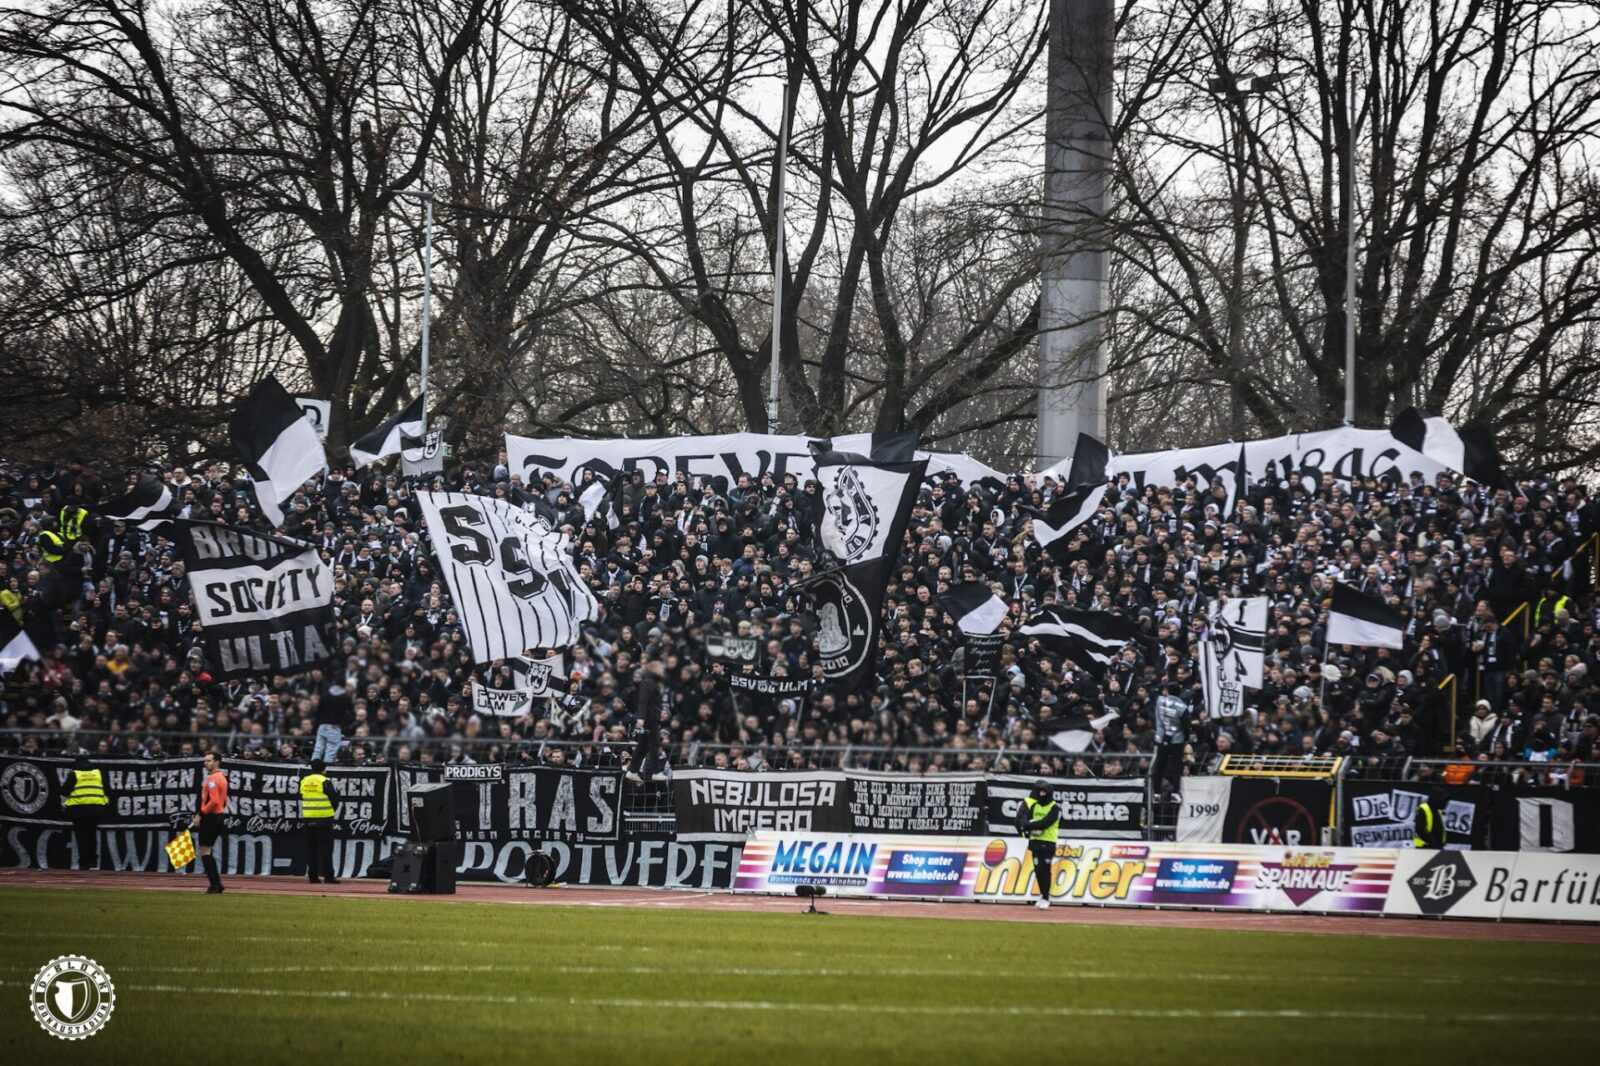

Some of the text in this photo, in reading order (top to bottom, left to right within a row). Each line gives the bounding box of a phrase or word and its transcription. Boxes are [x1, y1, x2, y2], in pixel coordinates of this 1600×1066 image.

[205, 564, 321, 618] SOCIETY
[446, 766, 501, 777] PRODIGYS
[108, 768, 196, 791] HALTEN
[262, 774, 377, 797] ZUSMEN
[854, 780, 976, 796] DAS ZIEL DAS IST EINE KURVE
[690, 780, 836, 806] NEBULOSA
[117, 794, 198, 816] GEHEN
[224, 796, 305, 818] NSERE
[886, 795, 921, 807] MINUTEN
[925, 796, 946, 807] LANG
[1355, 796, 1390, 819] Die
[878, 805, 913, 818] MINUTEN
[916, 806, 929, 818] AM
[1189, 804, 1220, 818] 1999
[855, 815, 870, 827] UND
[872, 817, 885, 828] DIE
[510, 830, 584, 842] SOCIETY
[1250, 827, 1302, 846] VAR
[771, 840, 878, 876] MEGAIN
[1055, 845, 1084, 858] öbel
[902, 853, 953, 867] Shop unter
[887, 869, 960, 881] www.inhofer.de
[973, 839, 1145, 900] inhofer
[1171, 861, 1224, 875] Shop unter
[769, 874, 811, 884] Wohntrends
[1155, 877, 1231, 890] www.inhofer.de
[1255, 867, 1353, 890] SPARKAUF
